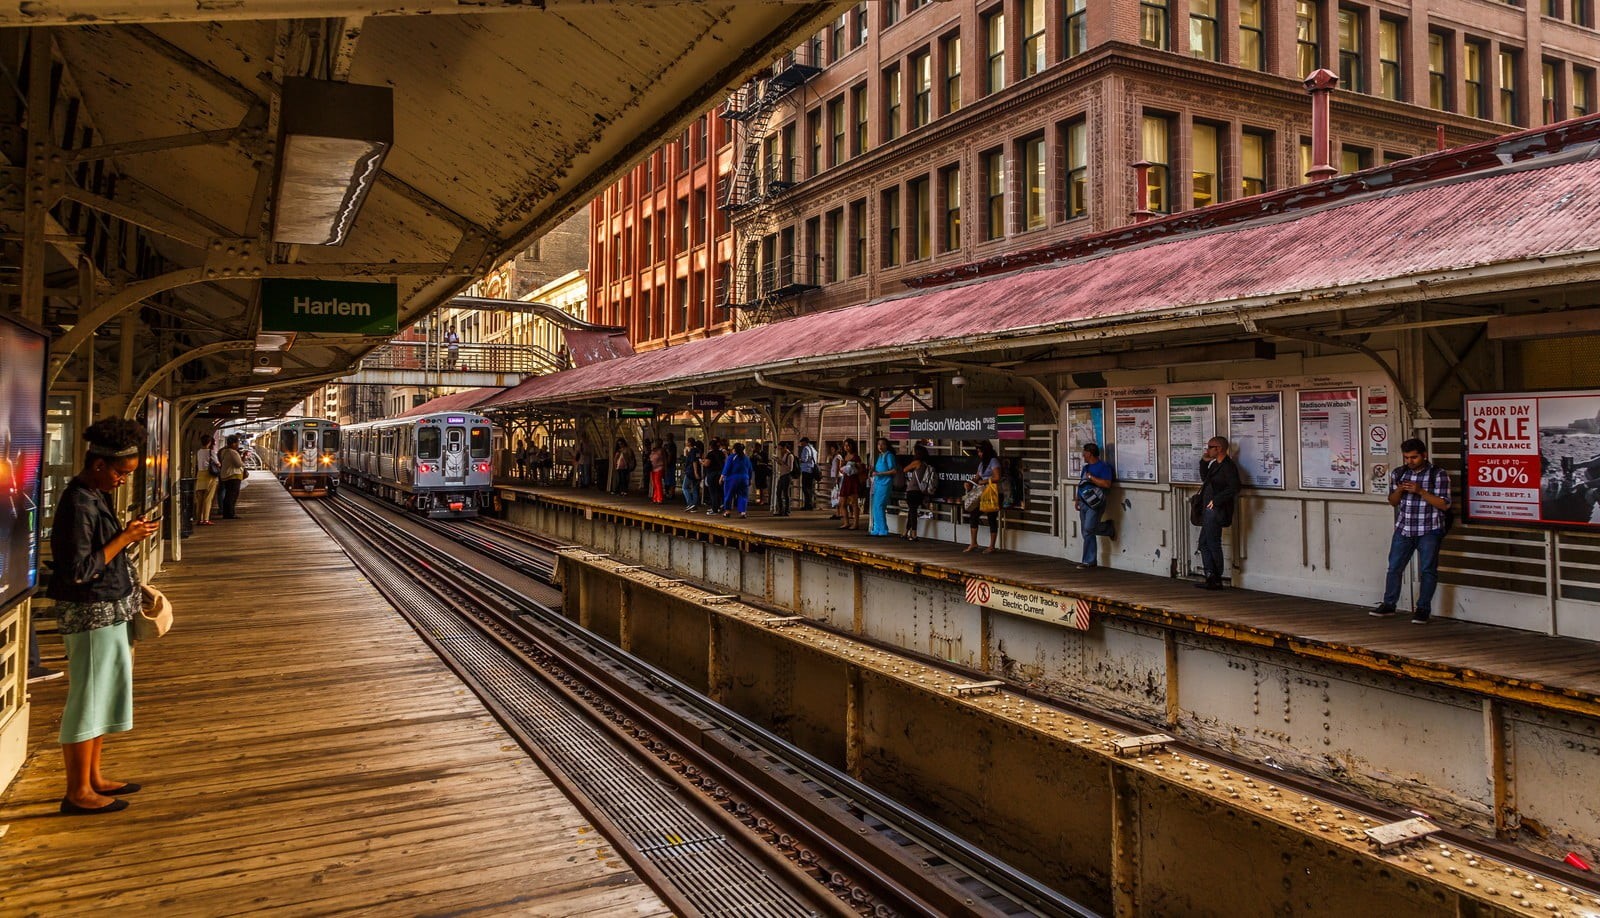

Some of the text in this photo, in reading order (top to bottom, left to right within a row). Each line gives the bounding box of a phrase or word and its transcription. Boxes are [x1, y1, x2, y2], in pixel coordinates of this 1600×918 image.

[293, 296, 371, 316] Harlem
[1473, 405, 1530, 416] LABOR DAY
[910, 417, 982, 432] Madison/Wabash
[1473, 417, 1531, 441] SALE
[1481, 442, 1532, 450] CLEARANCE
[945, 472, 960, 481] YOUR
[1478, 466, 1529, 484] 30%
[990, 586, 1010, 598] Danger
[1013, 591, 1028, 603] Keep
[1028, 594, 1039, 603] Off
[1040, 596, 1059, 609] Tracks
[1002, 598, 1045, 616] Electric Current
